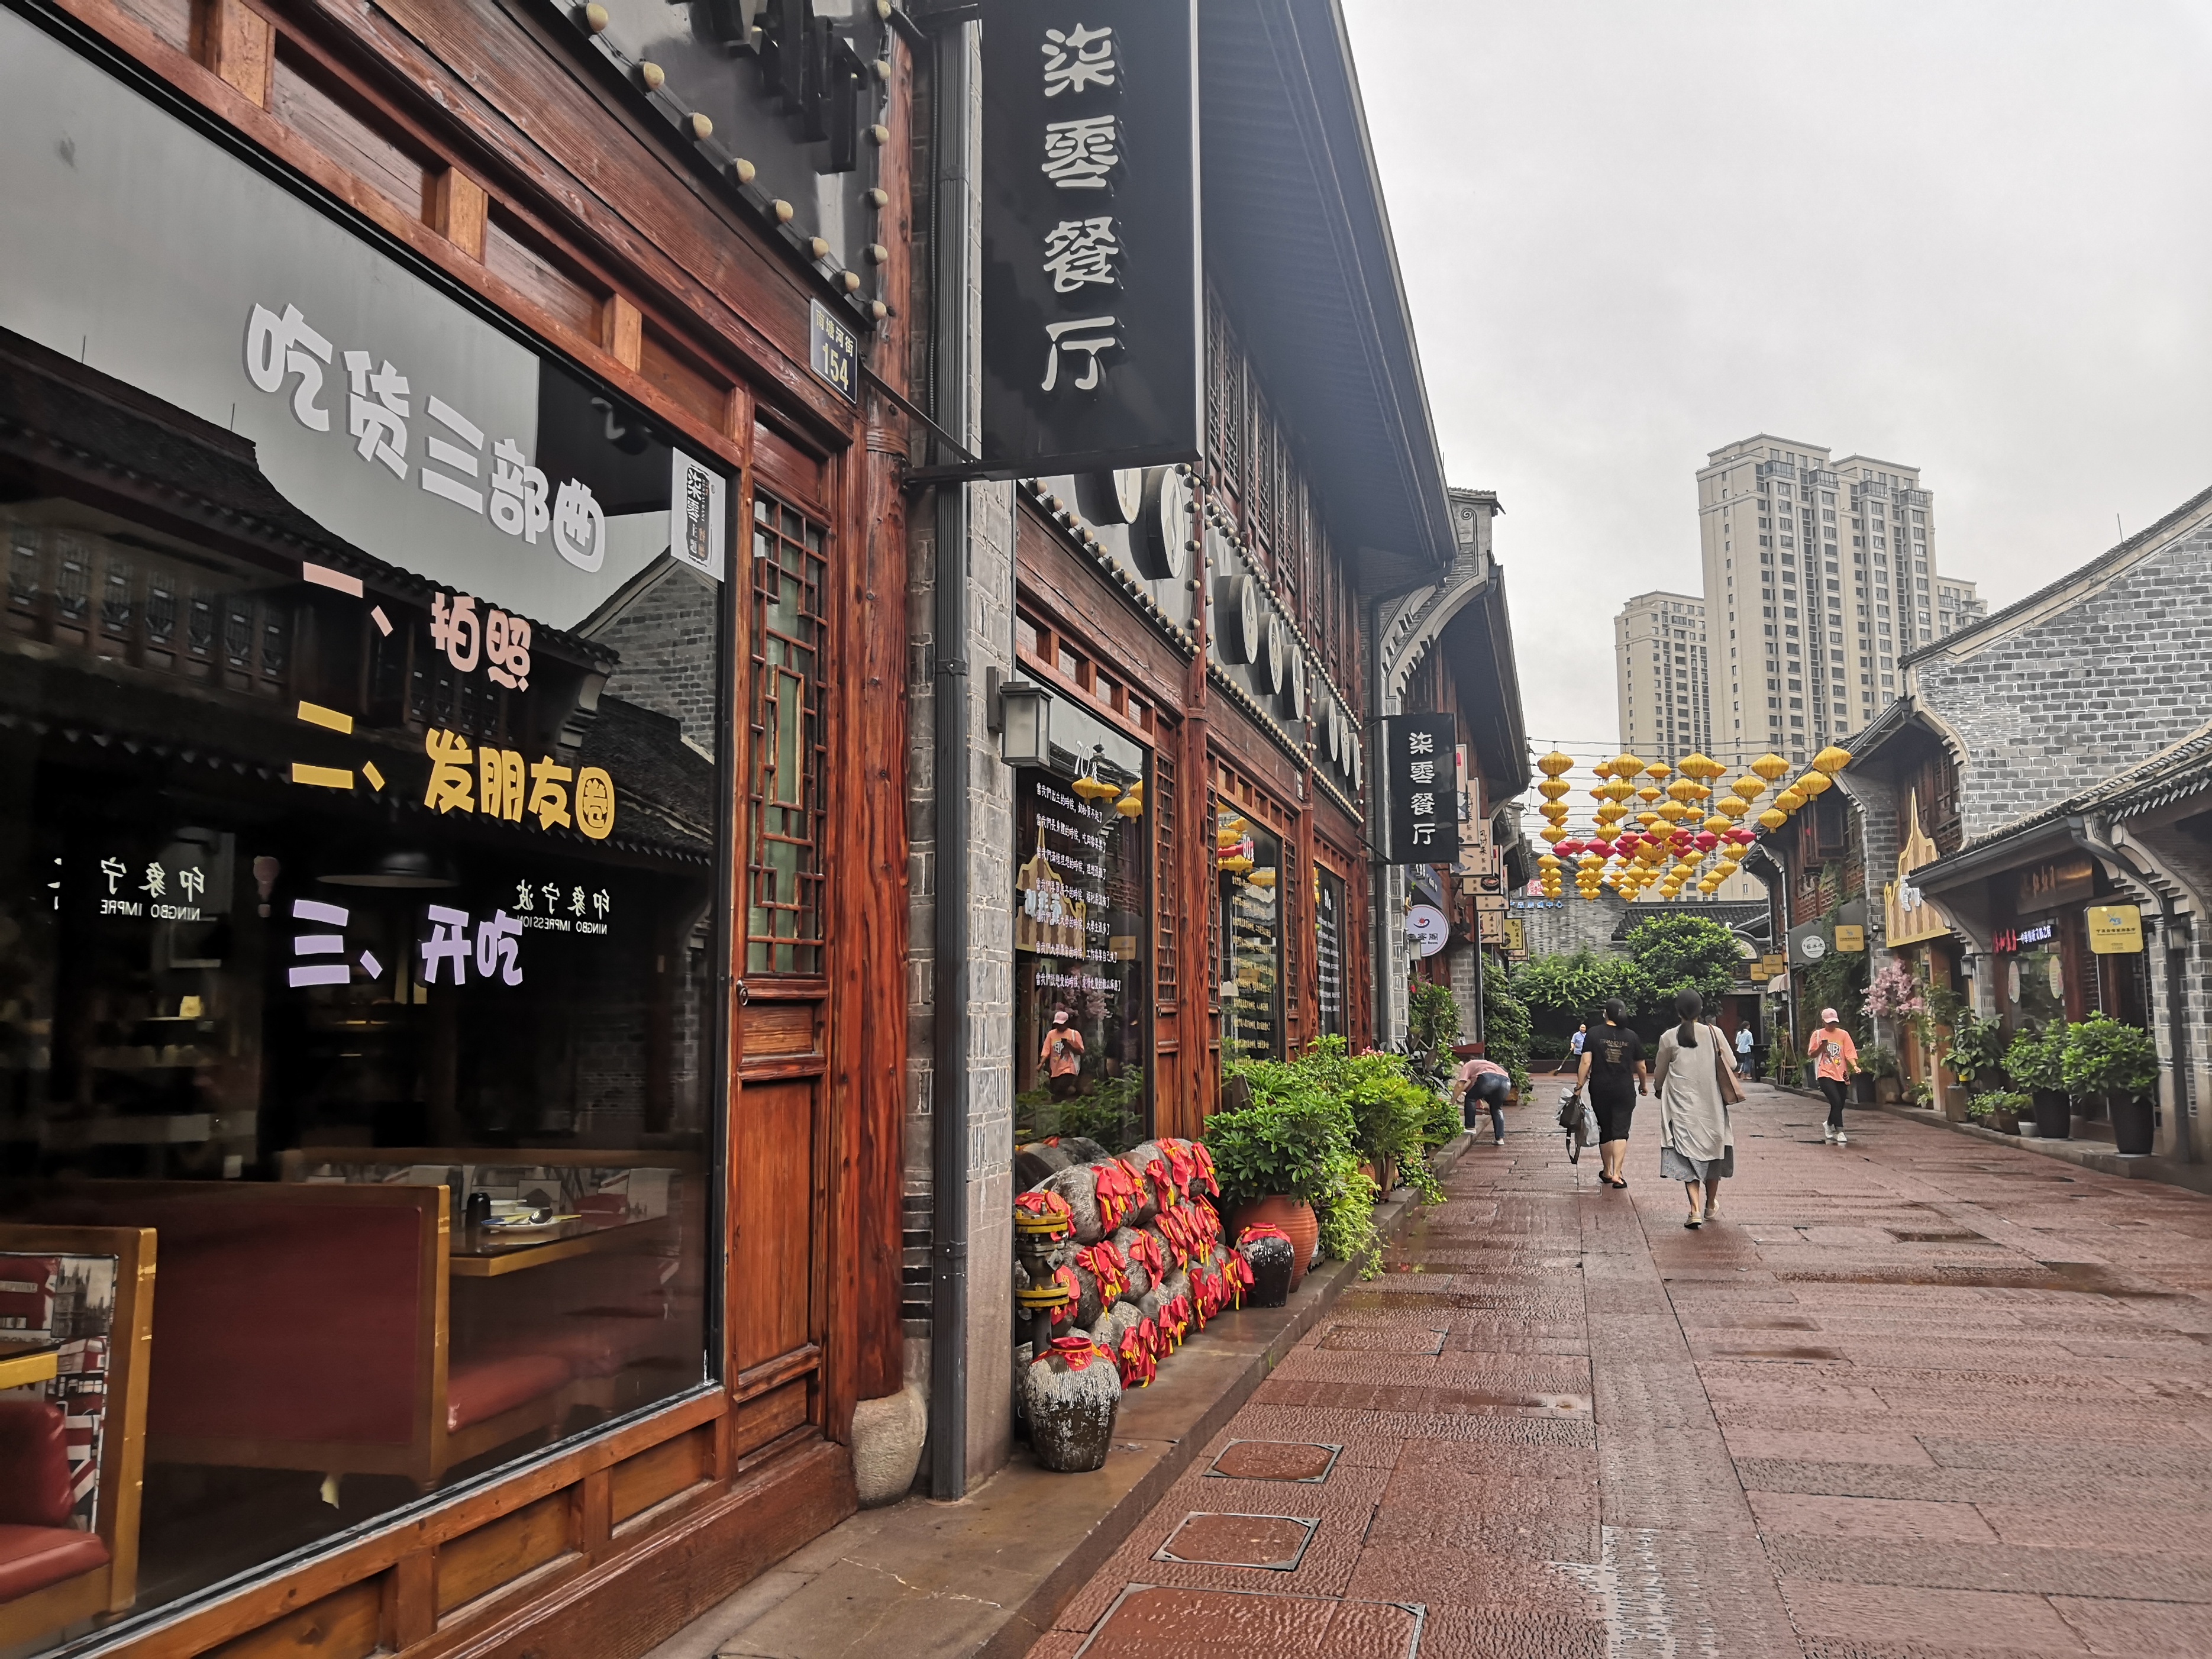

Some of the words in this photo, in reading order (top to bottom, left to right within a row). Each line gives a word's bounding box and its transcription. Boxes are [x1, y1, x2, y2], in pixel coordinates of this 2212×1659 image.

[816, 309, 853, 357] 南塘河街
[822, 343, 848, 391] 154
[246, 303, 606, 573] 吃货三部曲
[292, 700, 615, 840] 二、发朋友圈
[289, 899, 524, 987] 三、开吃
